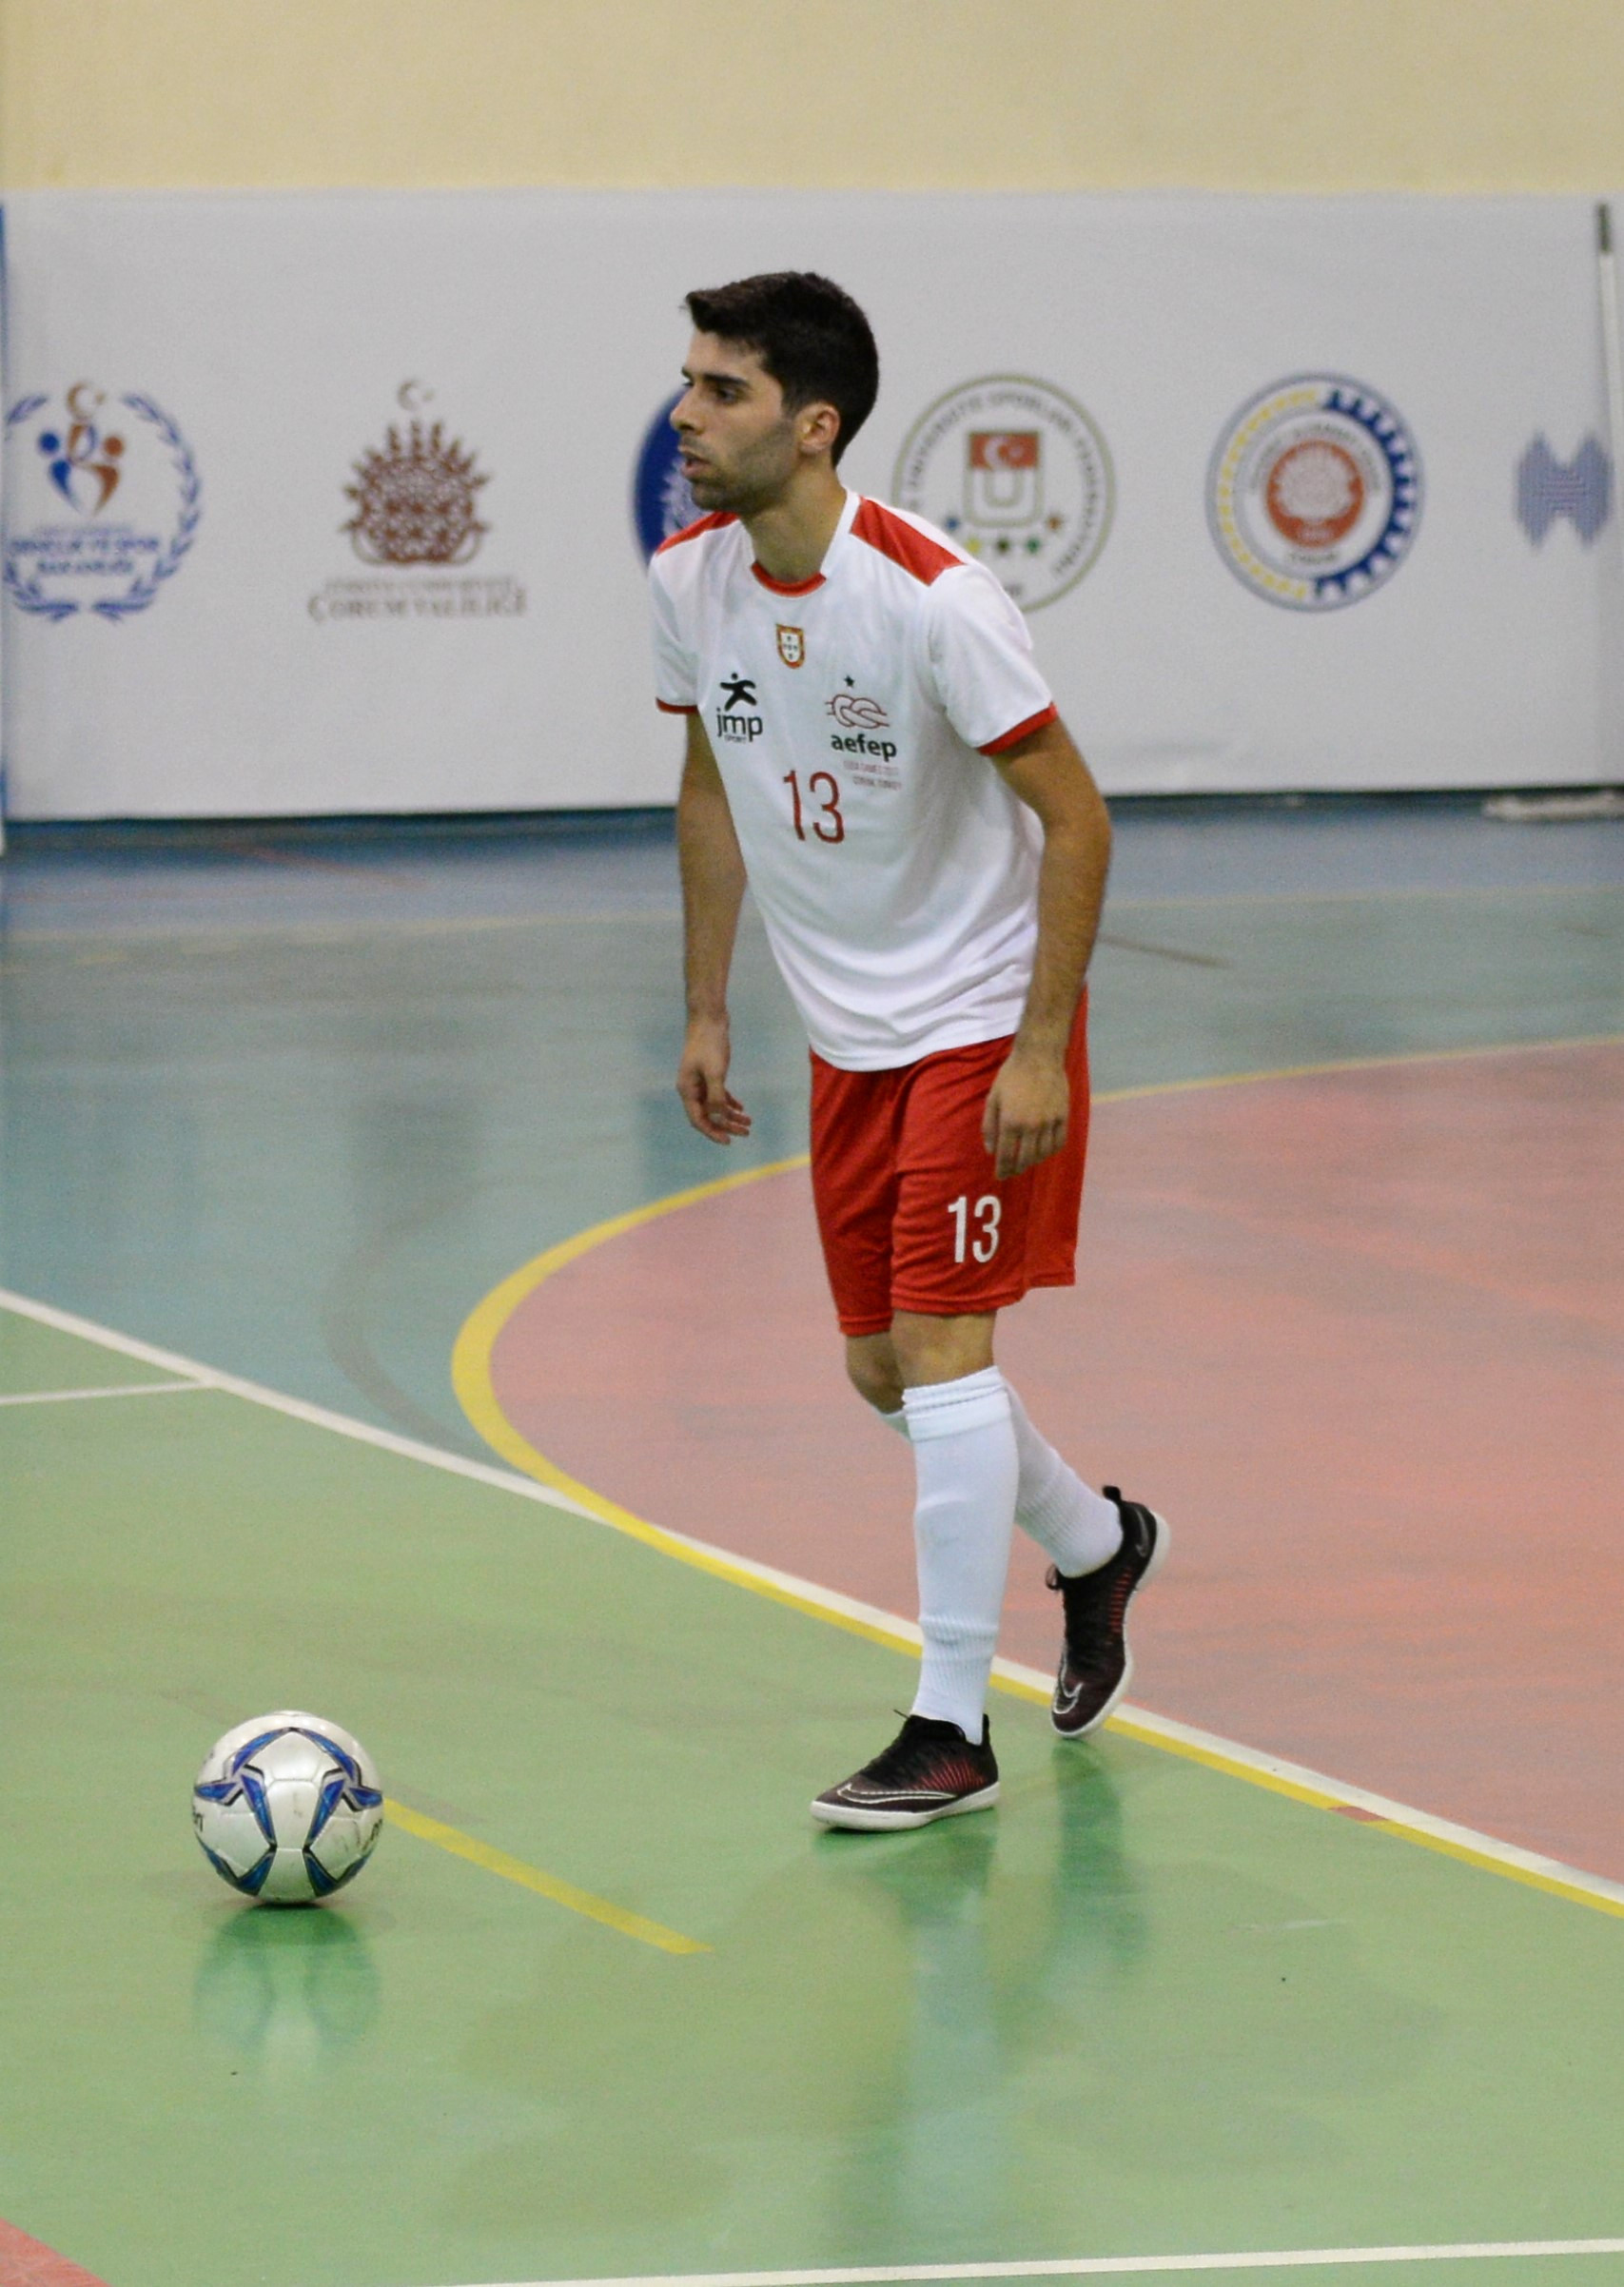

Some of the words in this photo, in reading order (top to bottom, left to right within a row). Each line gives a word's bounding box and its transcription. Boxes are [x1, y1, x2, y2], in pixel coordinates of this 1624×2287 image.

[716, 707, 763, 742] jmp
[831, 733, 897, 762] aefep
[783, 770, 845, 844] 13
[948, 1195, 1001, 1263] 13
